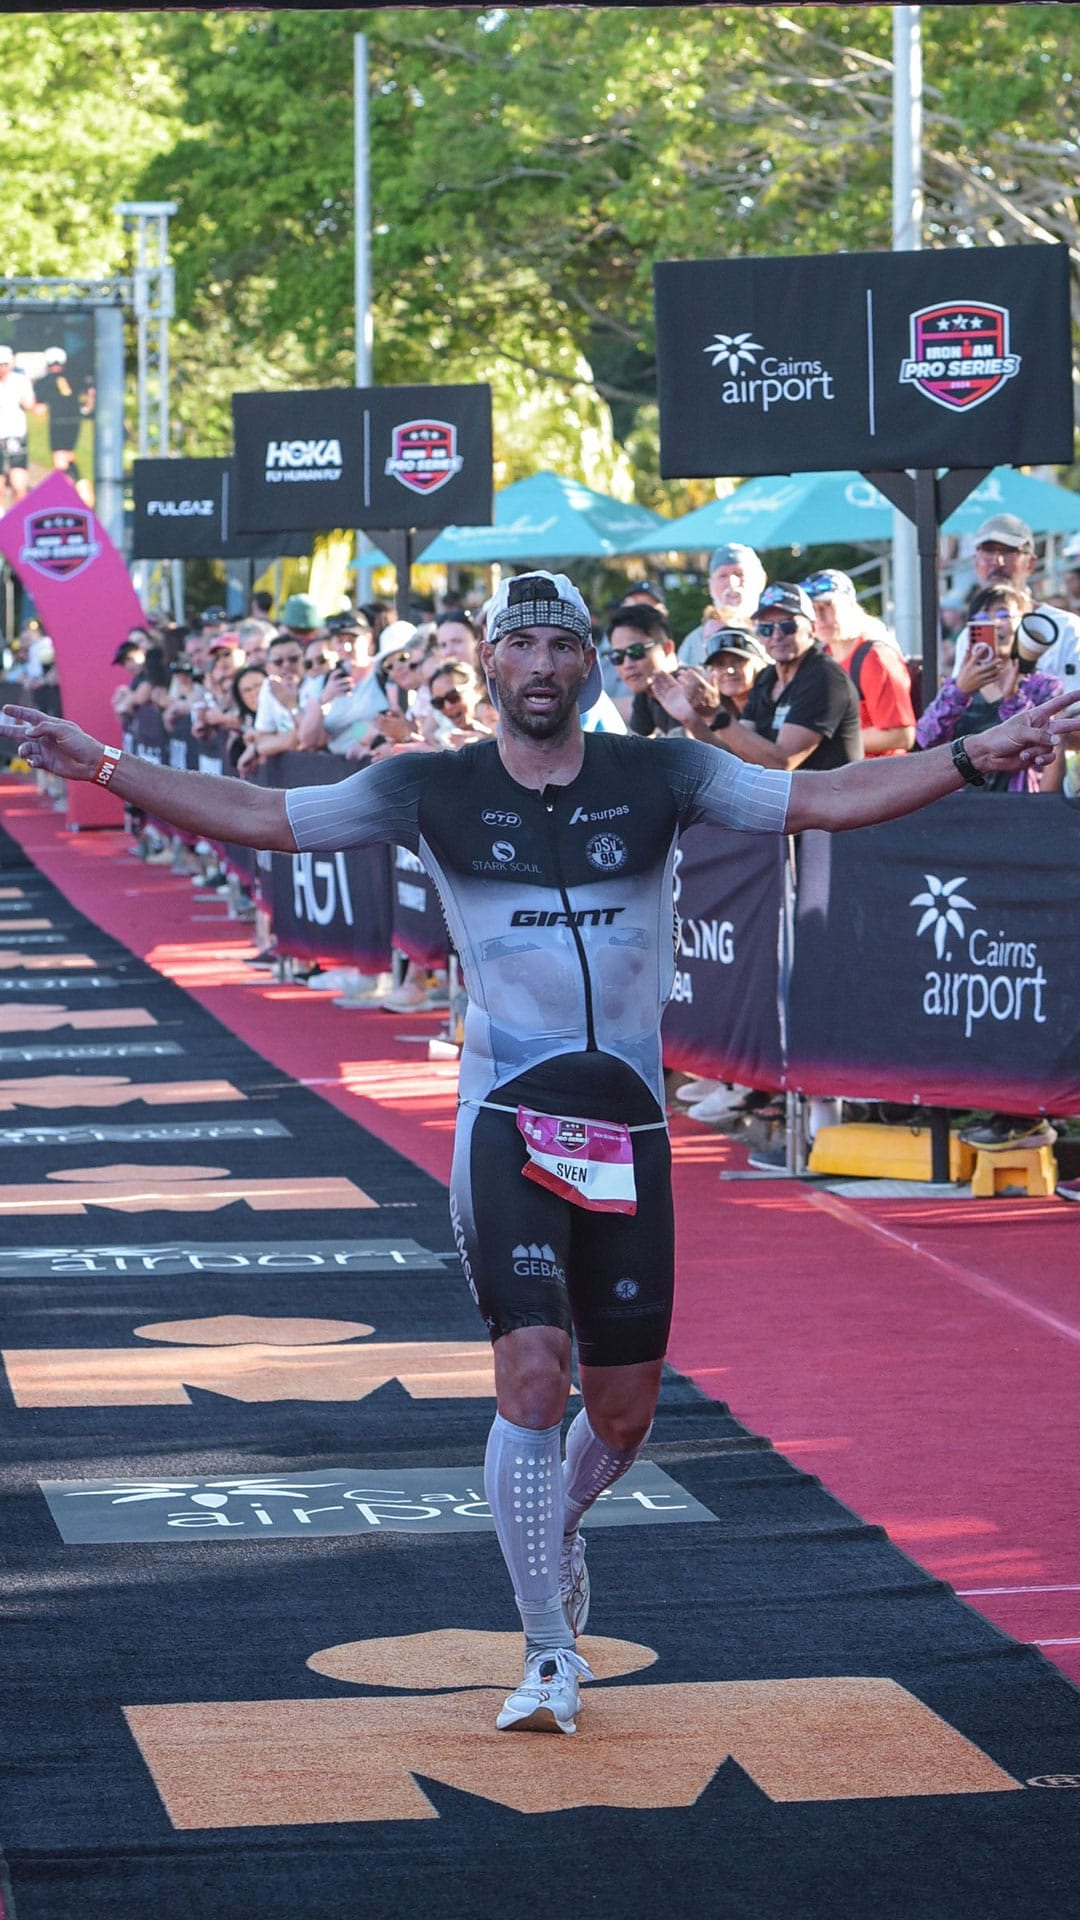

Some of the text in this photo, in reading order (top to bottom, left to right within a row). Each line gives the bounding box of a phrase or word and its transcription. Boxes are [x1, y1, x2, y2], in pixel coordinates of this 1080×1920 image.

[760, 357, 823, 376] Cairns
[905, 358, 1015, 378] PRO SERIES
[721, 371, 835, 411] airport
[265, 439, 343, 468] HOKA
[147, 500, 214, 517] FULGAZ
[590, 805, 630, 821] surpas
[472, 861, 543, 874] STARK SOUL
[600, 852, 617, 865] 98
[510, 907, 627, 928] GIANT
[968, 928, 1038, 969] Cairns
[923, 951, 1048, 1037] airport
[556, 1162, 587, 1183] SVEN
